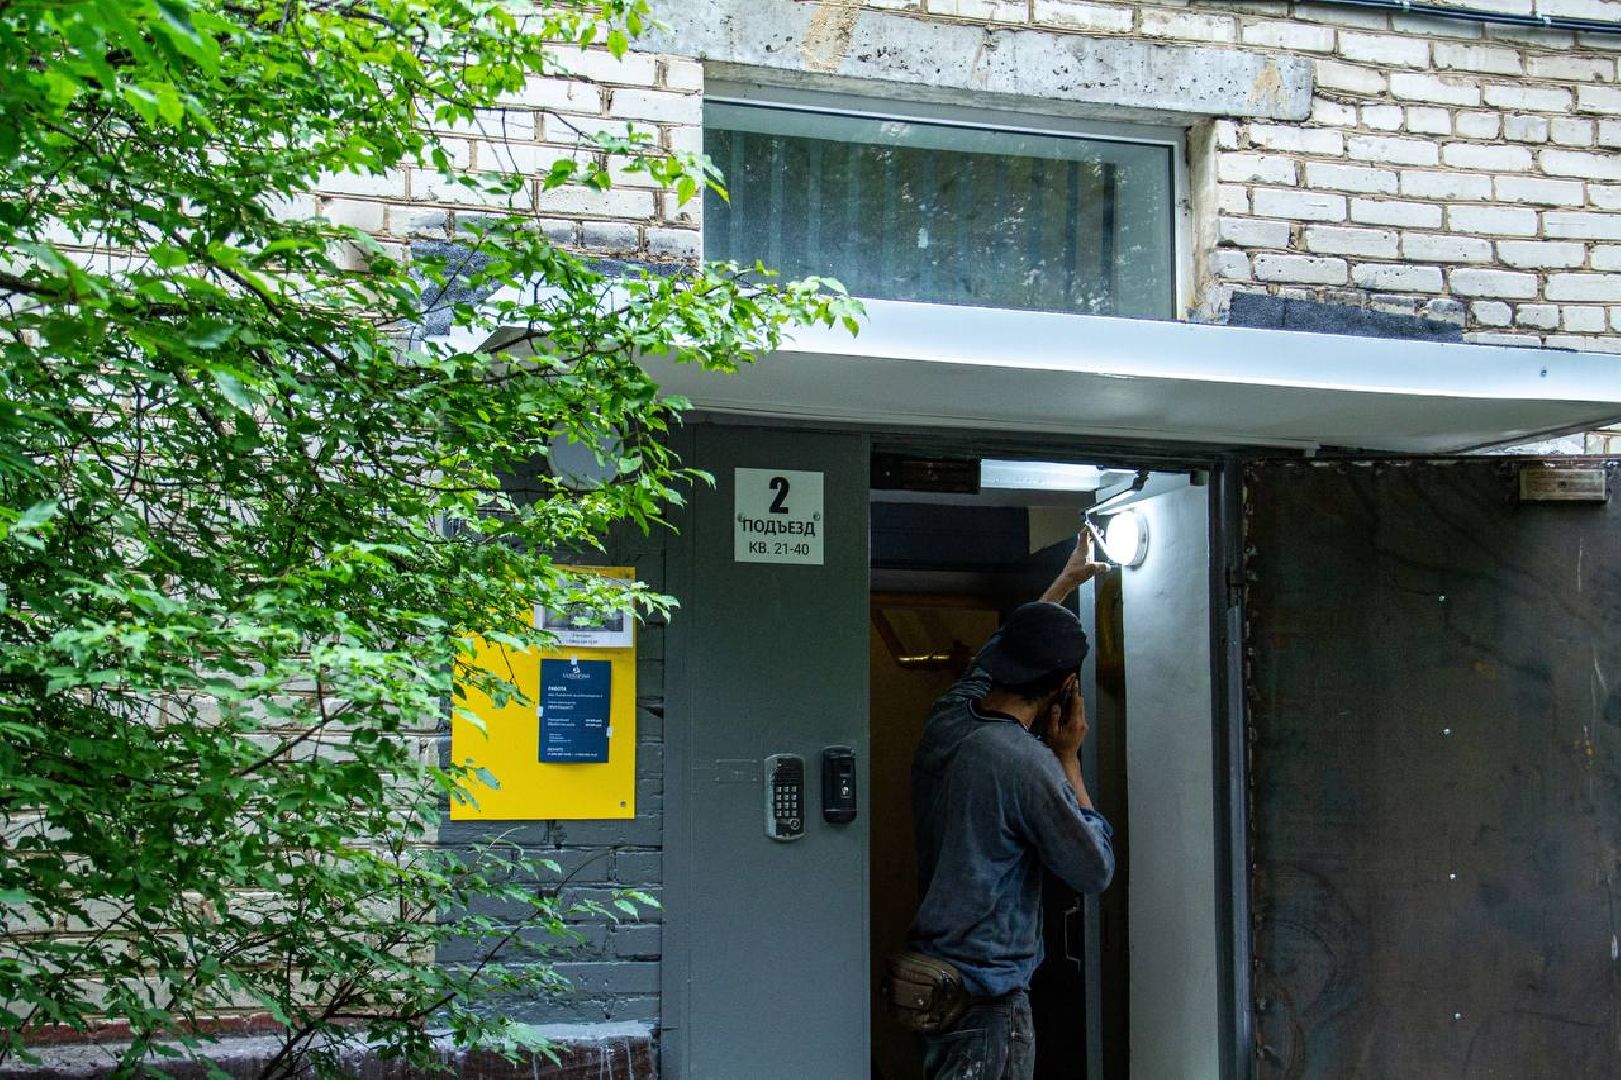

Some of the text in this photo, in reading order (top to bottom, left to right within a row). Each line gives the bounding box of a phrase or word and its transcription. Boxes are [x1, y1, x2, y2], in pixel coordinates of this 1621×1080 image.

[769, 477, 789, 514] 2
[743, 519, 816, 536] ПОДЪЕЗД
[749, 541, 810, 555] КВ. 21-40
